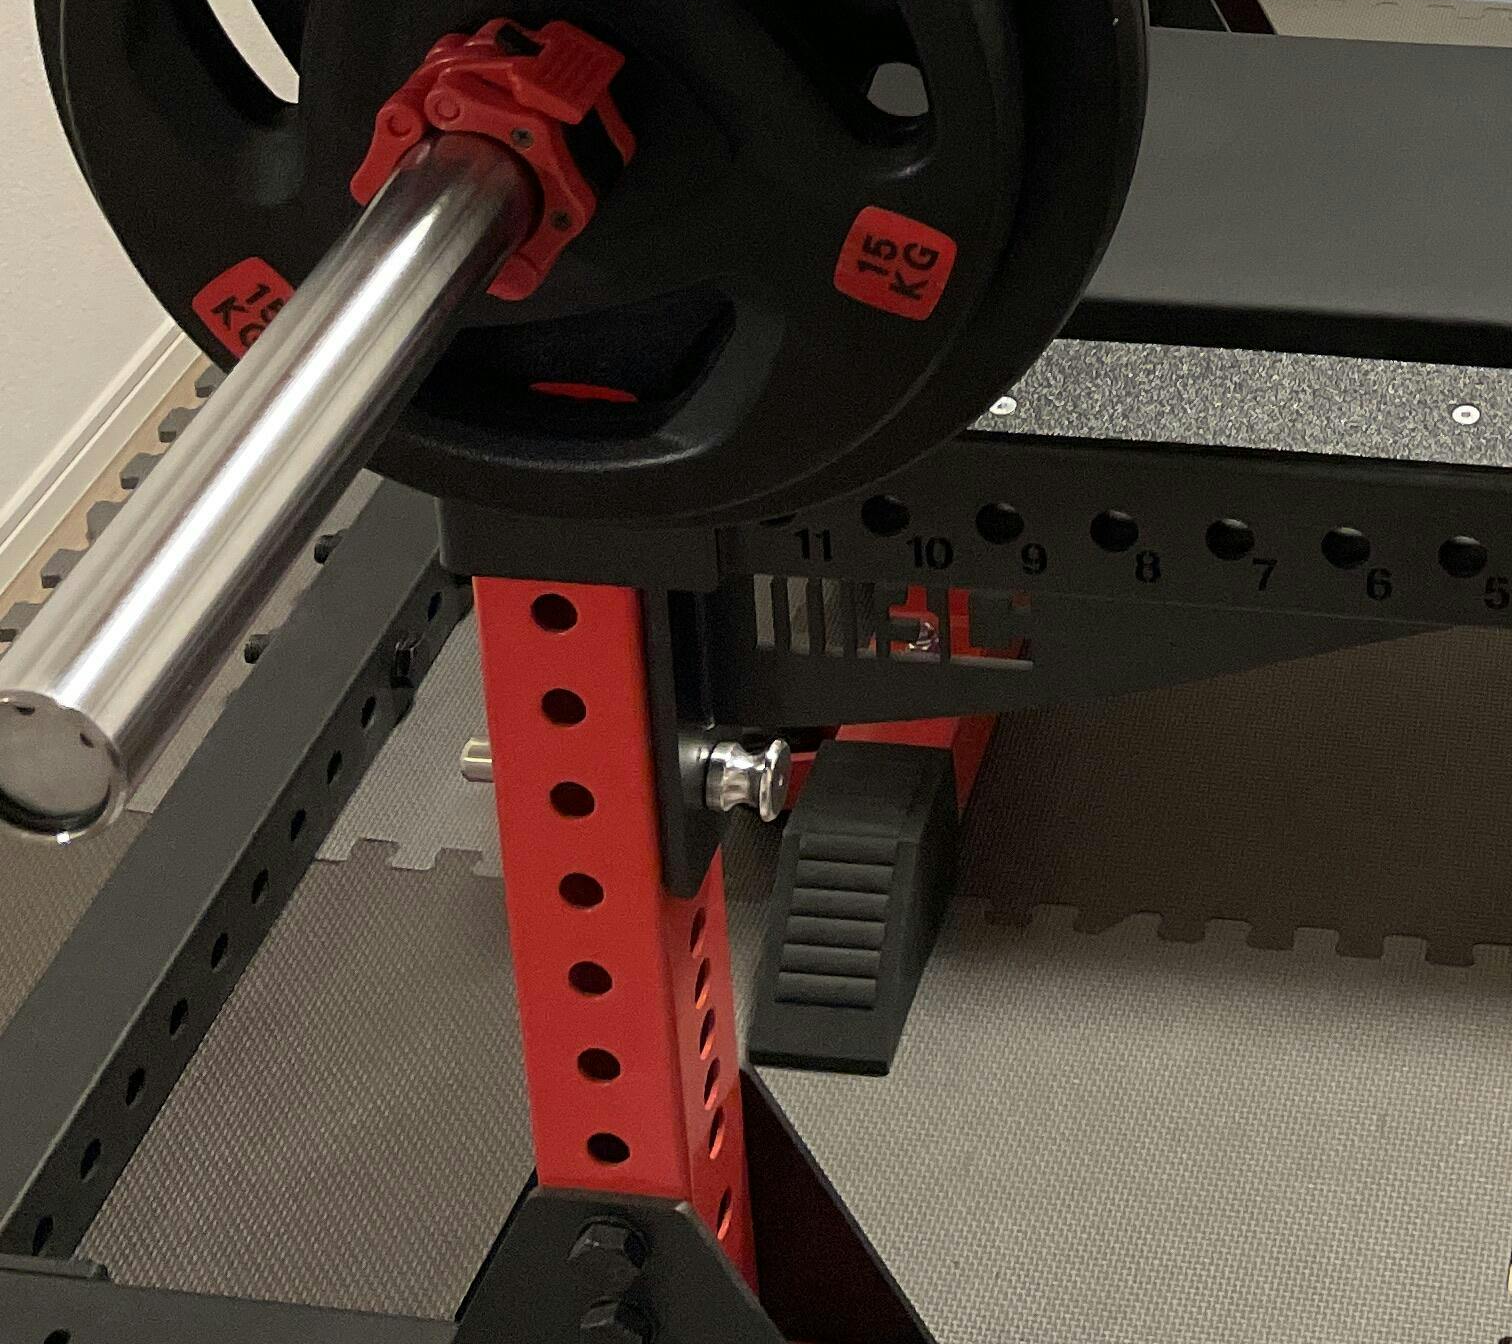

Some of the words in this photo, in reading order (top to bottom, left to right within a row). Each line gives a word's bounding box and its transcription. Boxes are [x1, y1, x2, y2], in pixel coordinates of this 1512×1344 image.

[857, 233, 898, 276] 15
[889, 242, 941, 301] KG
[795, 527, 833, 562] 11
[906, 533, 954, 570] 10
[1020, 541, 1048, 576] 9
[1134, 549, 1162, 584] 8
[1252, 557, 1278, 592] 7
[1365, 567, 1393, 602] 6
[1483, 576, 1511, 610] 5
